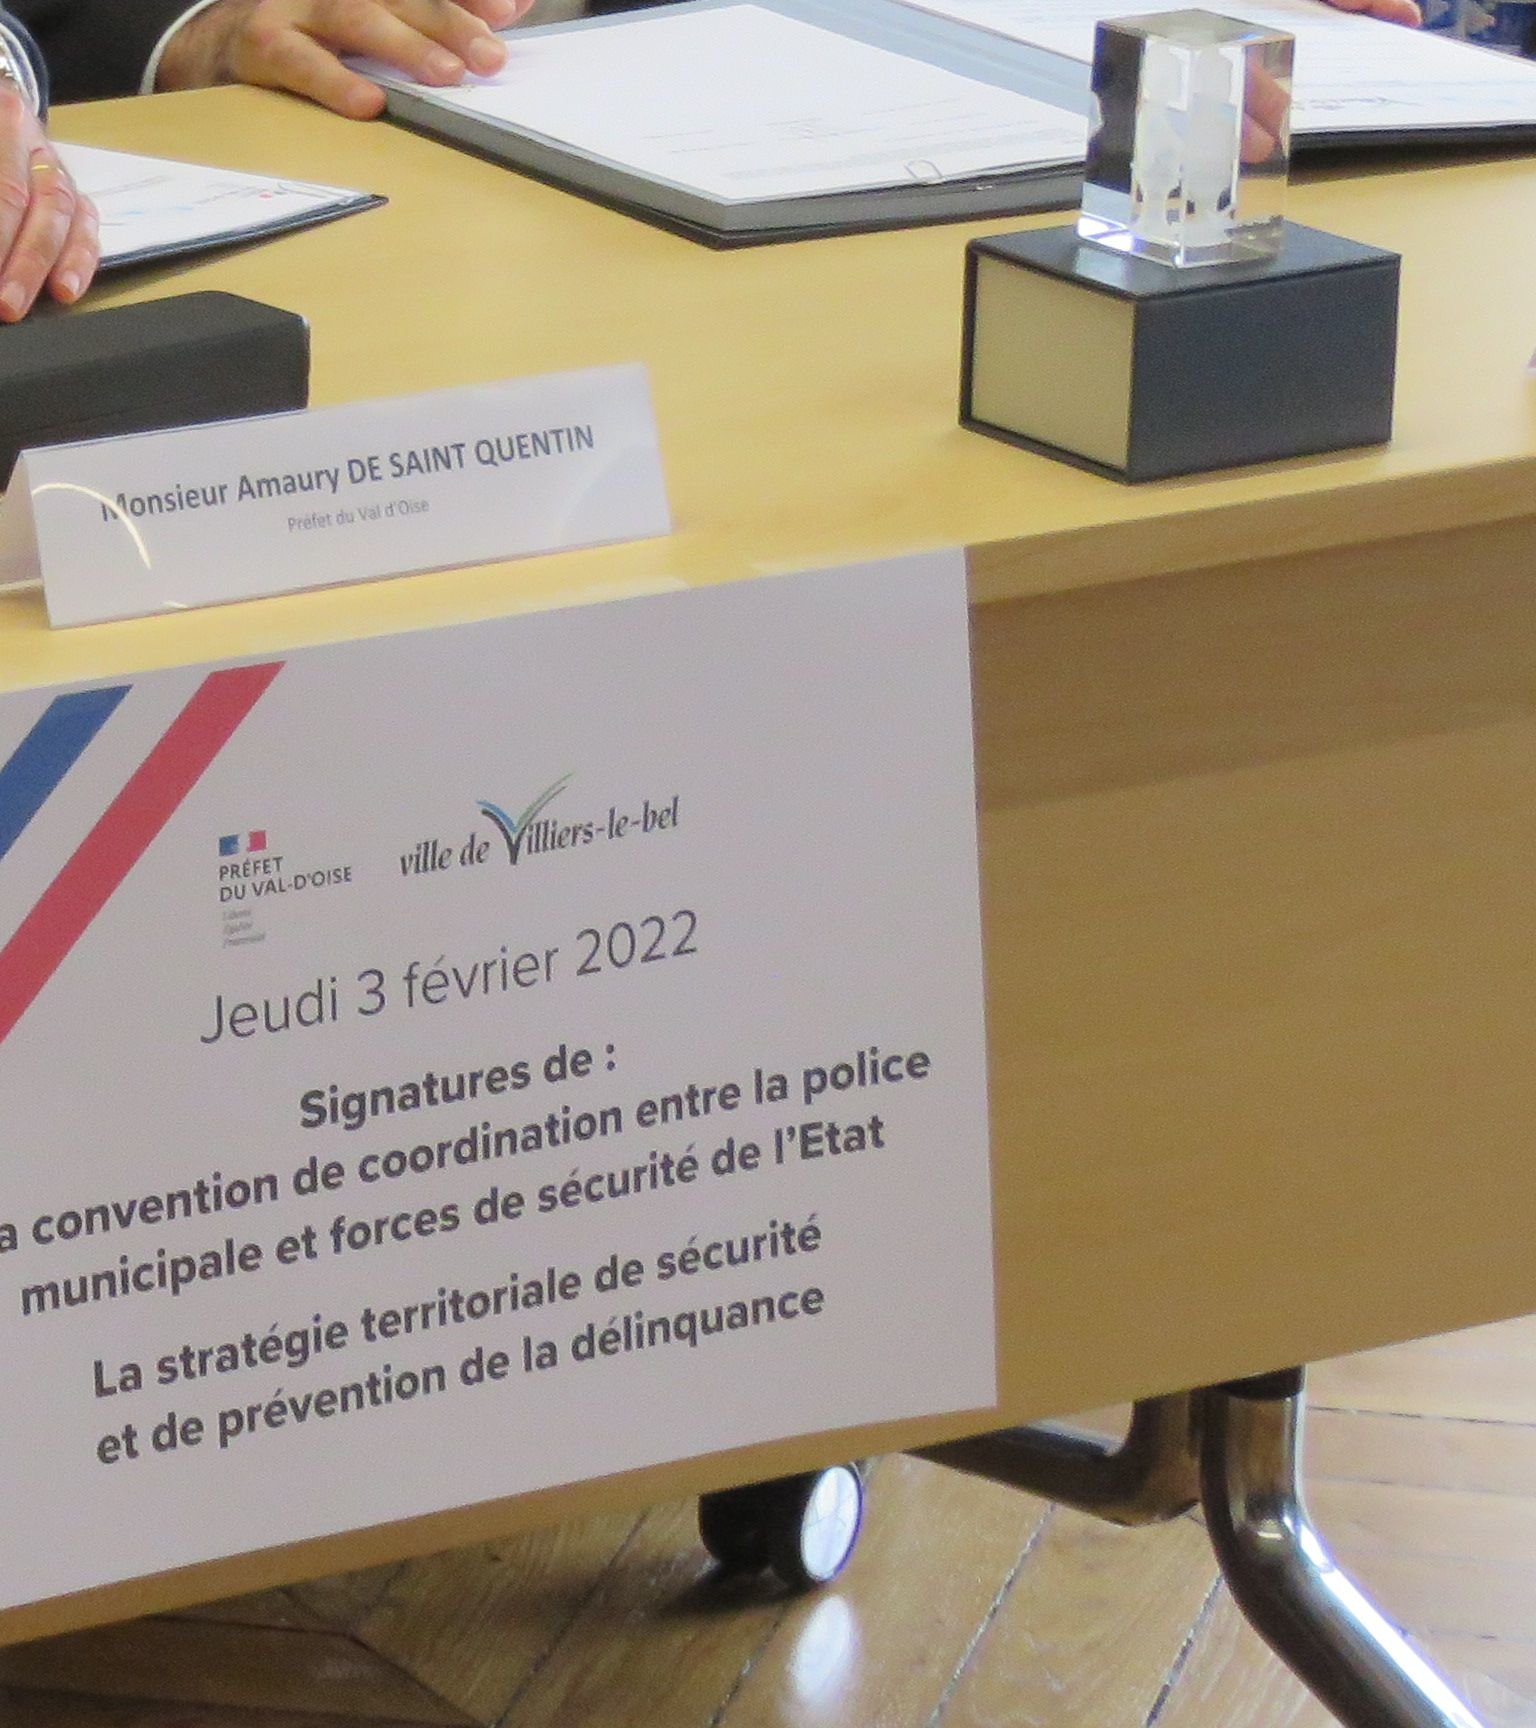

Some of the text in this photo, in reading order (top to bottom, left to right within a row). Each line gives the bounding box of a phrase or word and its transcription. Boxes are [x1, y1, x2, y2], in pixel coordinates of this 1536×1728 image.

[101, 424, 595, 522] Monsieur Amaury DE SAINT QUENTIN
[287, 498, 430, 533] Préfet du Val d'Oise
[219, 856, 284, 882] PRÉFET
[220, 866, 353, 903] DU VAL-D'OISE
[399, 838, 452, 876] ville
[459, 832, 490, 867] de
[200, 909, 698, 1044] Jeudi 3 février 2022
[300, 1060, 532, 1131] Signatures
[543, 1043, 593, 1083] de
[32, 1171, 278, 1245] convention
[293, 1155, 345, 1196] de
[358, 1104, 623, 1183] coordination
[636, 1082, 741, 1128] entre
[755, 1068, 788, 1105] la
[803, 1046, 930, 1105] police
[21, 1115, 885, 1316] municipale et forces de sécurité de l'Etat
[93, 1213, 822, 1398] La stratégie territoriale de sécurité
[96, 1286, 825, 1465] et de prévention de la délinquance
